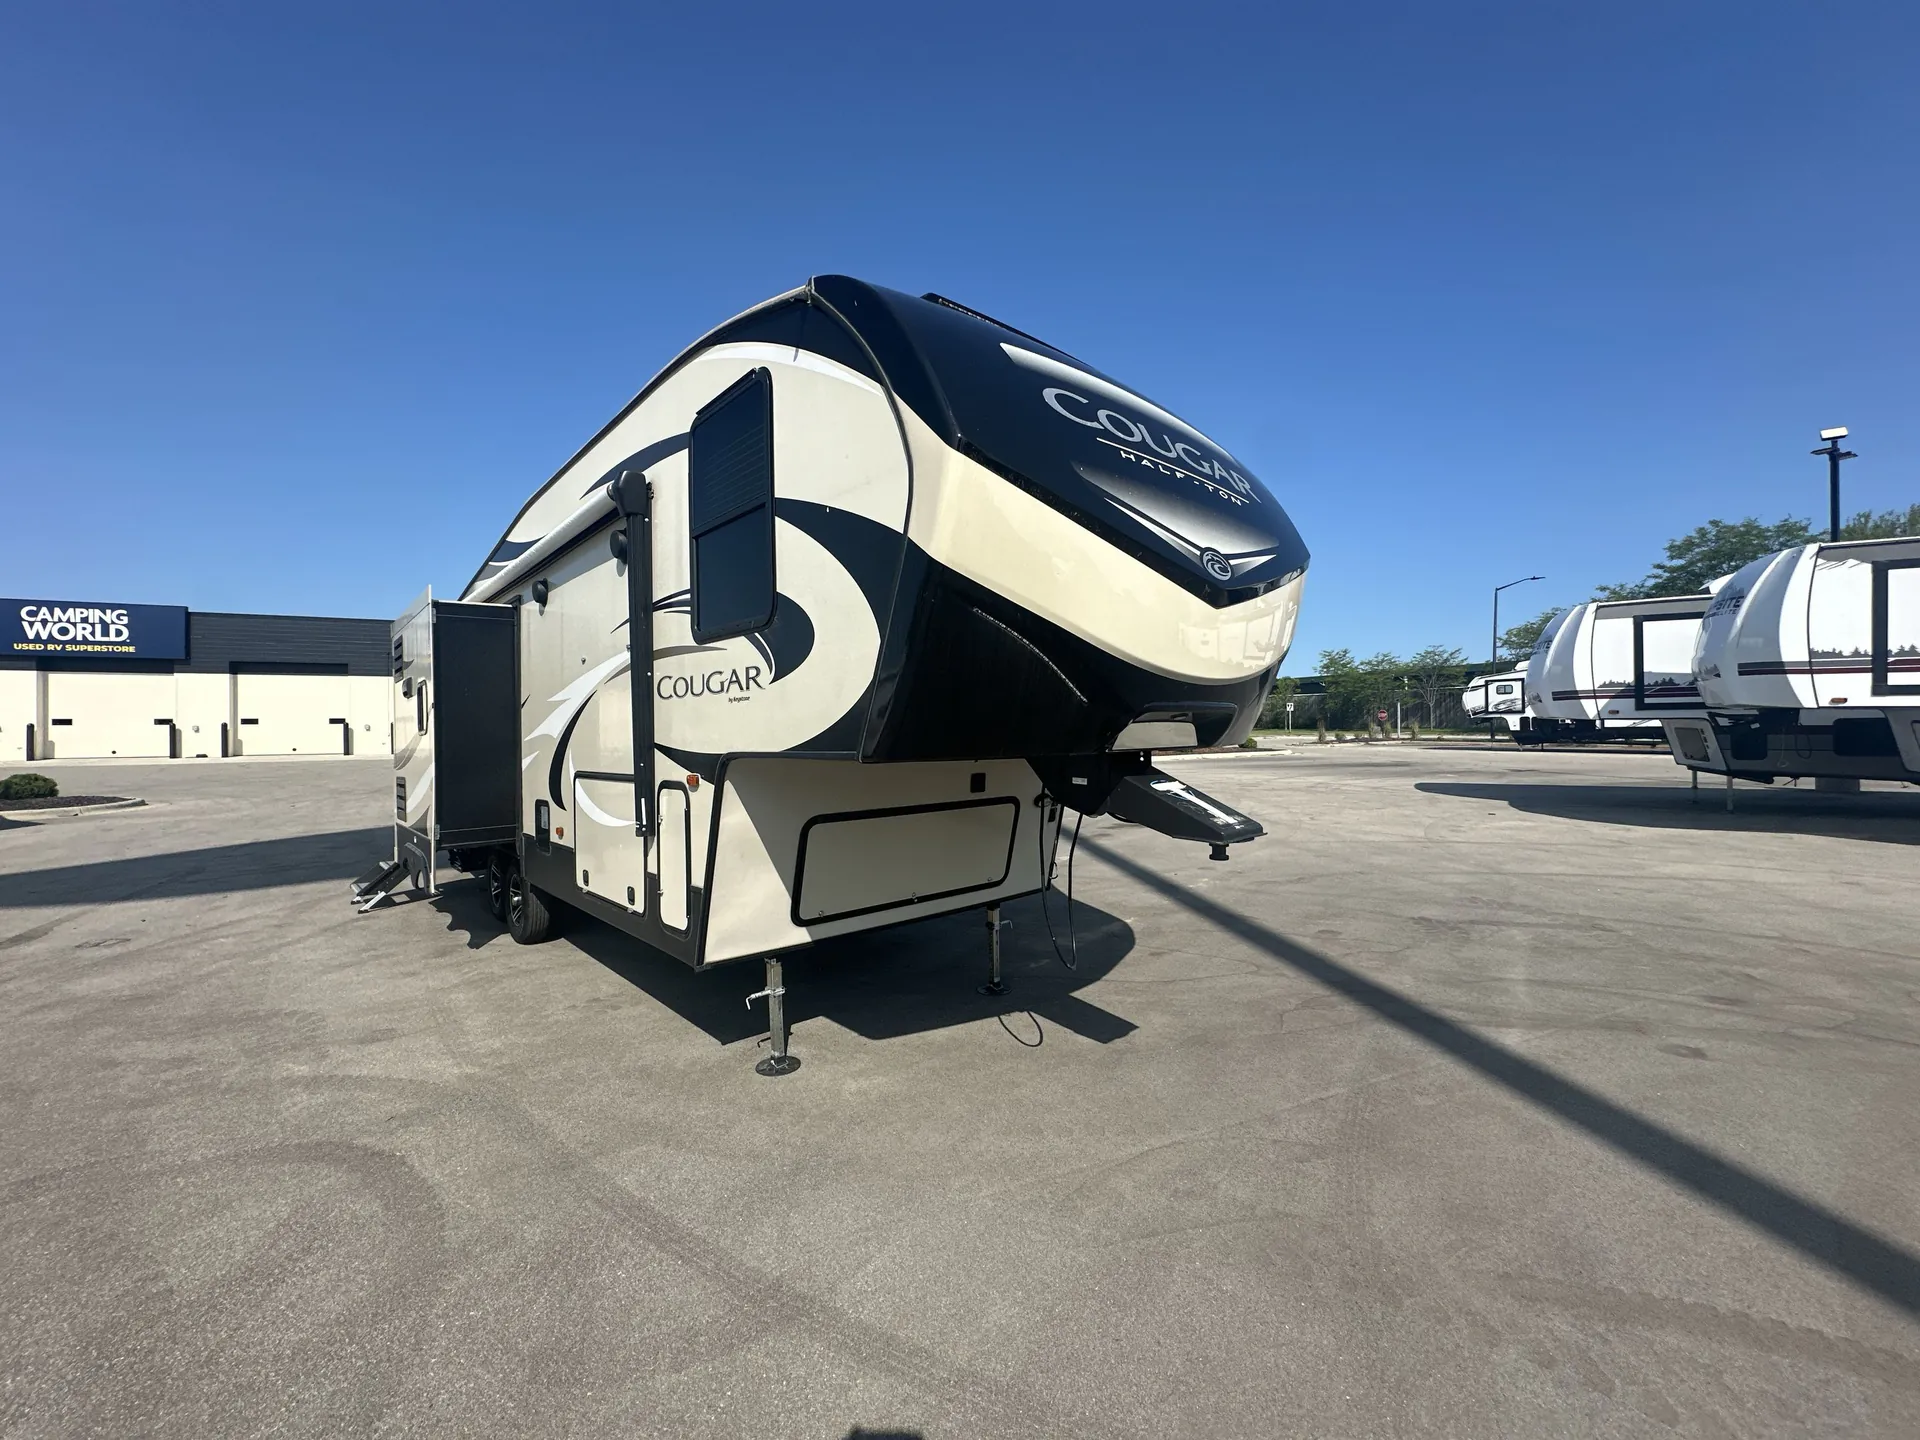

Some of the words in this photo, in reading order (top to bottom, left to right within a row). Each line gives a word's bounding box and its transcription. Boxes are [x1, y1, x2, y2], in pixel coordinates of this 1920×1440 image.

[1042, 387, 1262, 504] COUGAR
[20, 605, 129, 625] CAMPING
[13, 643, 45, 651] USED
[65, 644, 136, 653] SUPERSTORE
[656, 665, 766, 700] COUGAR
